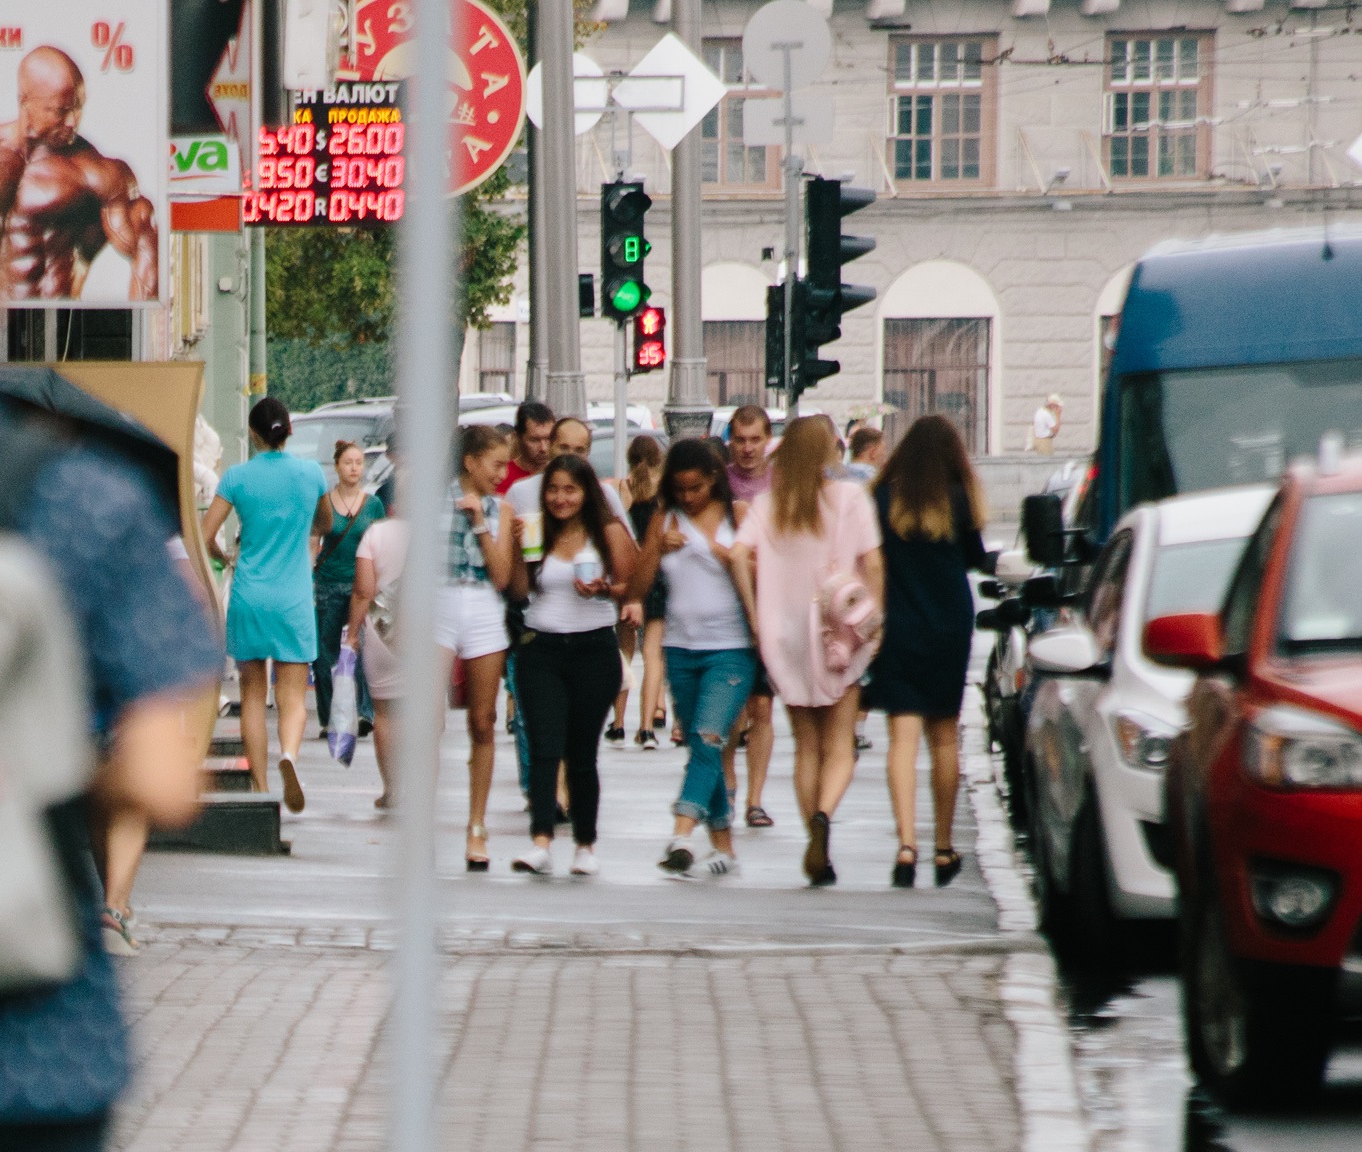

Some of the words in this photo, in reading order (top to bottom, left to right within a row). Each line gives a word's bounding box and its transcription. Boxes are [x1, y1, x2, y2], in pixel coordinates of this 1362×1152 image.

[91, 21, 134, 73] %
[293, 86, 317, 104] ЕН
[322, 83, 400, 104] ВАЛЮТ
[293, 107, 313, 124] КА
[328, 107, 402, 125] ПРОДАЖА
[258, 124, 315, 155] 5.40
[315, 129, 327, 151] $
[170, 141, 228, 172] va
[315, 163, 328, 183] €
[315, 198, 327, 217] R
[625, 236, 639, 263] 8
